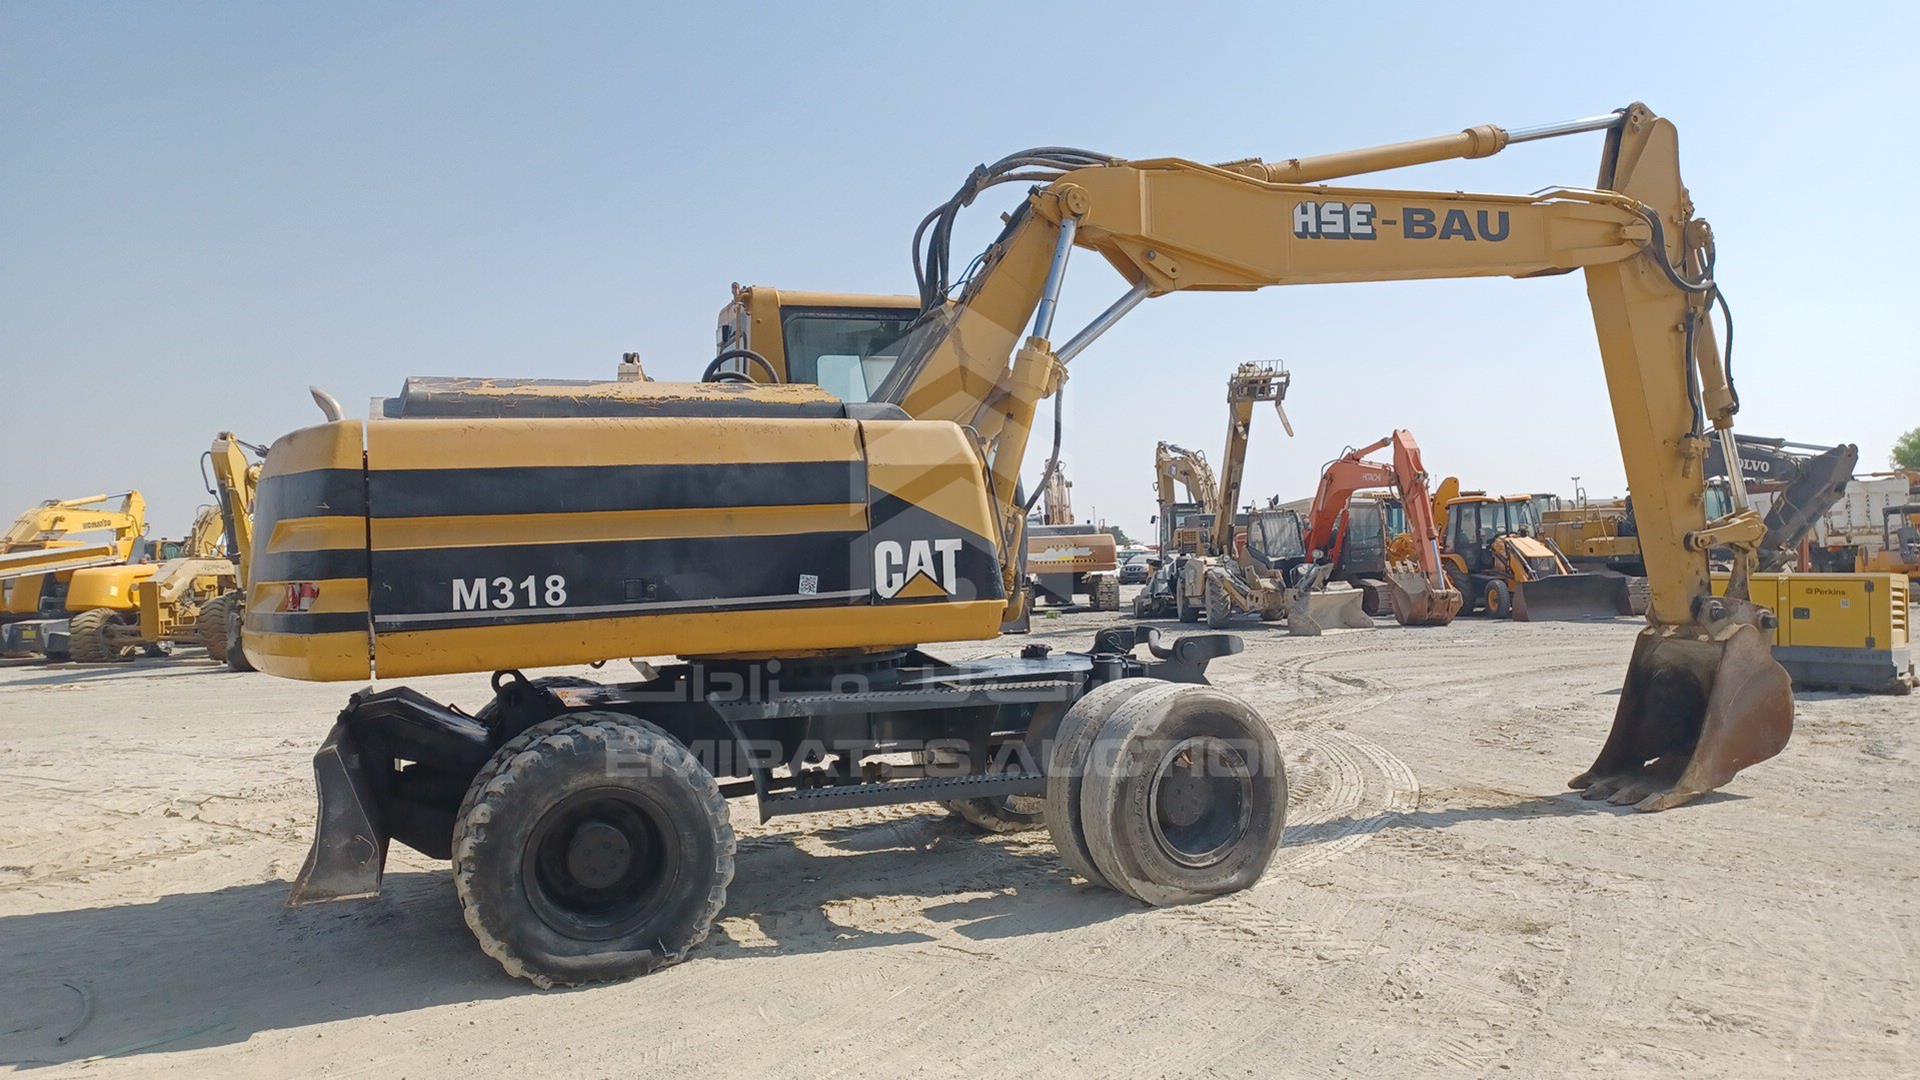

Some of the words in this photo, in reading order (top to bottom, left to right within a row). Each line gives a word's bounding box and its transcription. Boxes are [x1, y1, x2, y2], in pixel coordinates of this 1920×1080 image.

[1737, 457, 1770, 473] OLVO
[874, 538, 963, 599] CAT
[452, 574, 568, 611] M318
